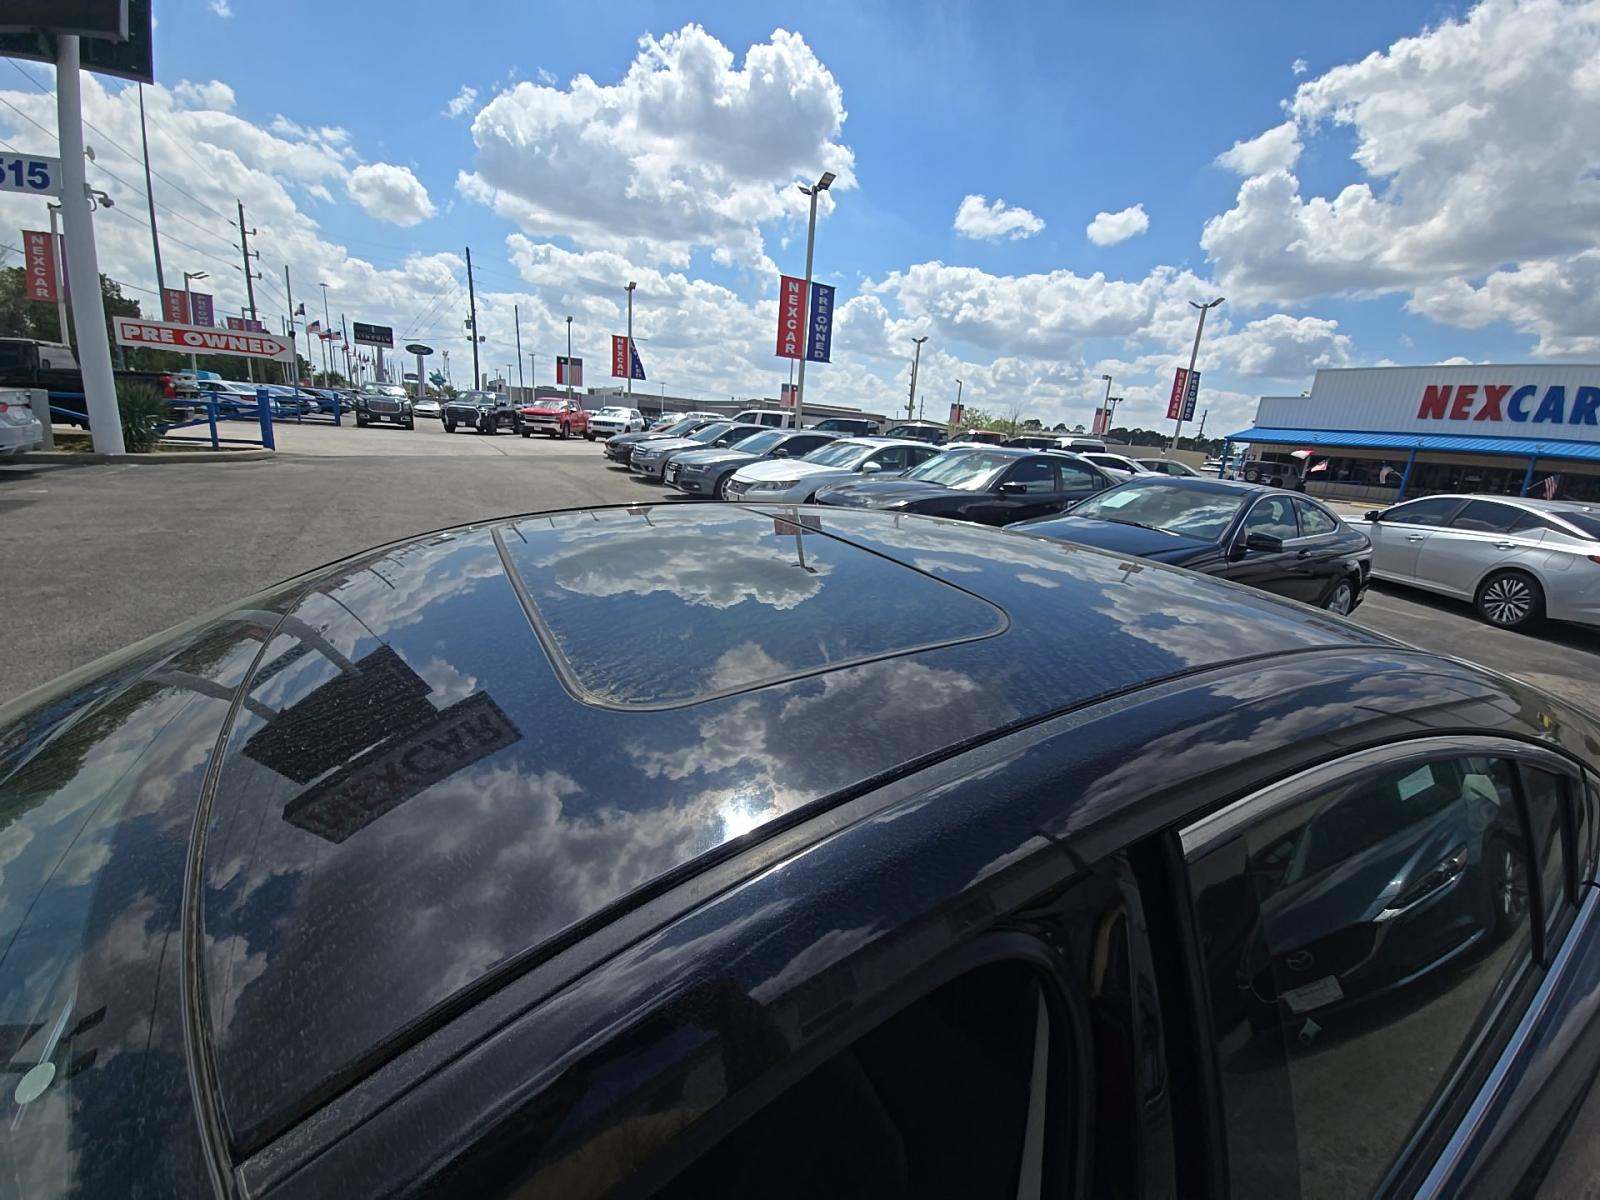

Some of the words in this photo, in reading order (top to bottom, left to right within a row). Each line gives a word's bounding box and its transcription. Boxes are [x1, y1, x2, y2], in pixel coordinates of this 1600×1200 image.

[0, 157, 50, 190] 15
[31, 235, 49, 297] NEXCAR
[123, 325, 175, 343] PRE
[183, 332, 280, 354] OWNED
[785, 281, 799, 354] NEXCAR
[814, 287, 829, 359] PREOWNED
[1417, 384, 1600, 425] NEXCAR
